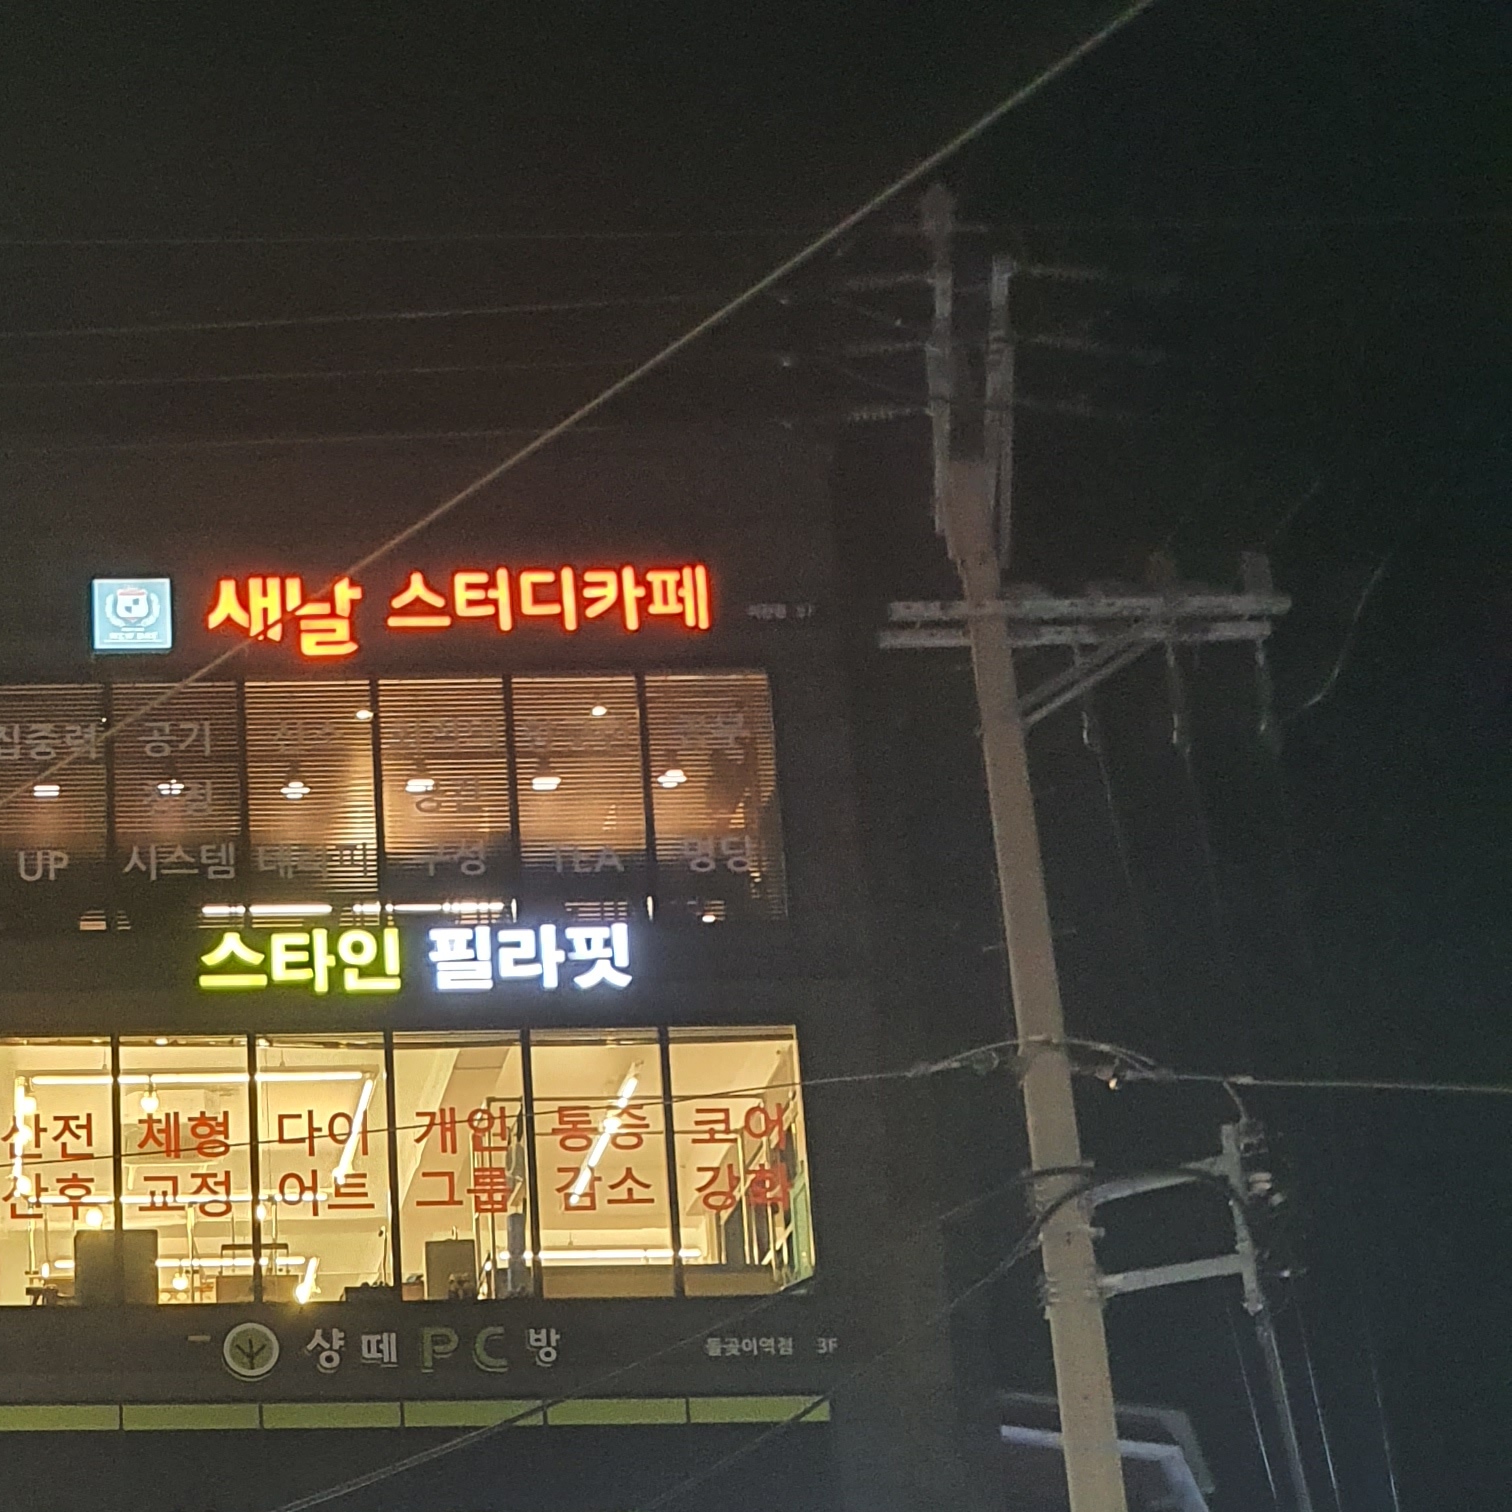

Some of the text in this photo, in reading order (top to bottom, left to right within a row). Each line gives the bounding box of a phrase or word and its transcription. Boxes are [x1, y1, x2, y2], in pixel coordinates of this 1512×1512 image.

[207, 564, 712, 658] 새날 스터디카페
[136, 720, 213, 758] 공기
[17, 849, 69, 882] UP
[122, 841, 236, 882] 시스템
[199, 922, 633, 993] 스타인 필라핏
[136, 1109, 231, 1159] 체형
[277, 1109, 370, 1157] 다이
[414, 1106, 509, 1154] 개인
[551, 1103, 651, 1153] 통증
[691, 1102, 786, 1150] 코어
[137, 1169, 234, 1218] 교정
[277, 1169, 375, 1217] 어트
[415, 1166, 513, 1214] 그룹
[555, 1166, 655, 1212] 감소
[816, 1337, 838, 1354] 3F
